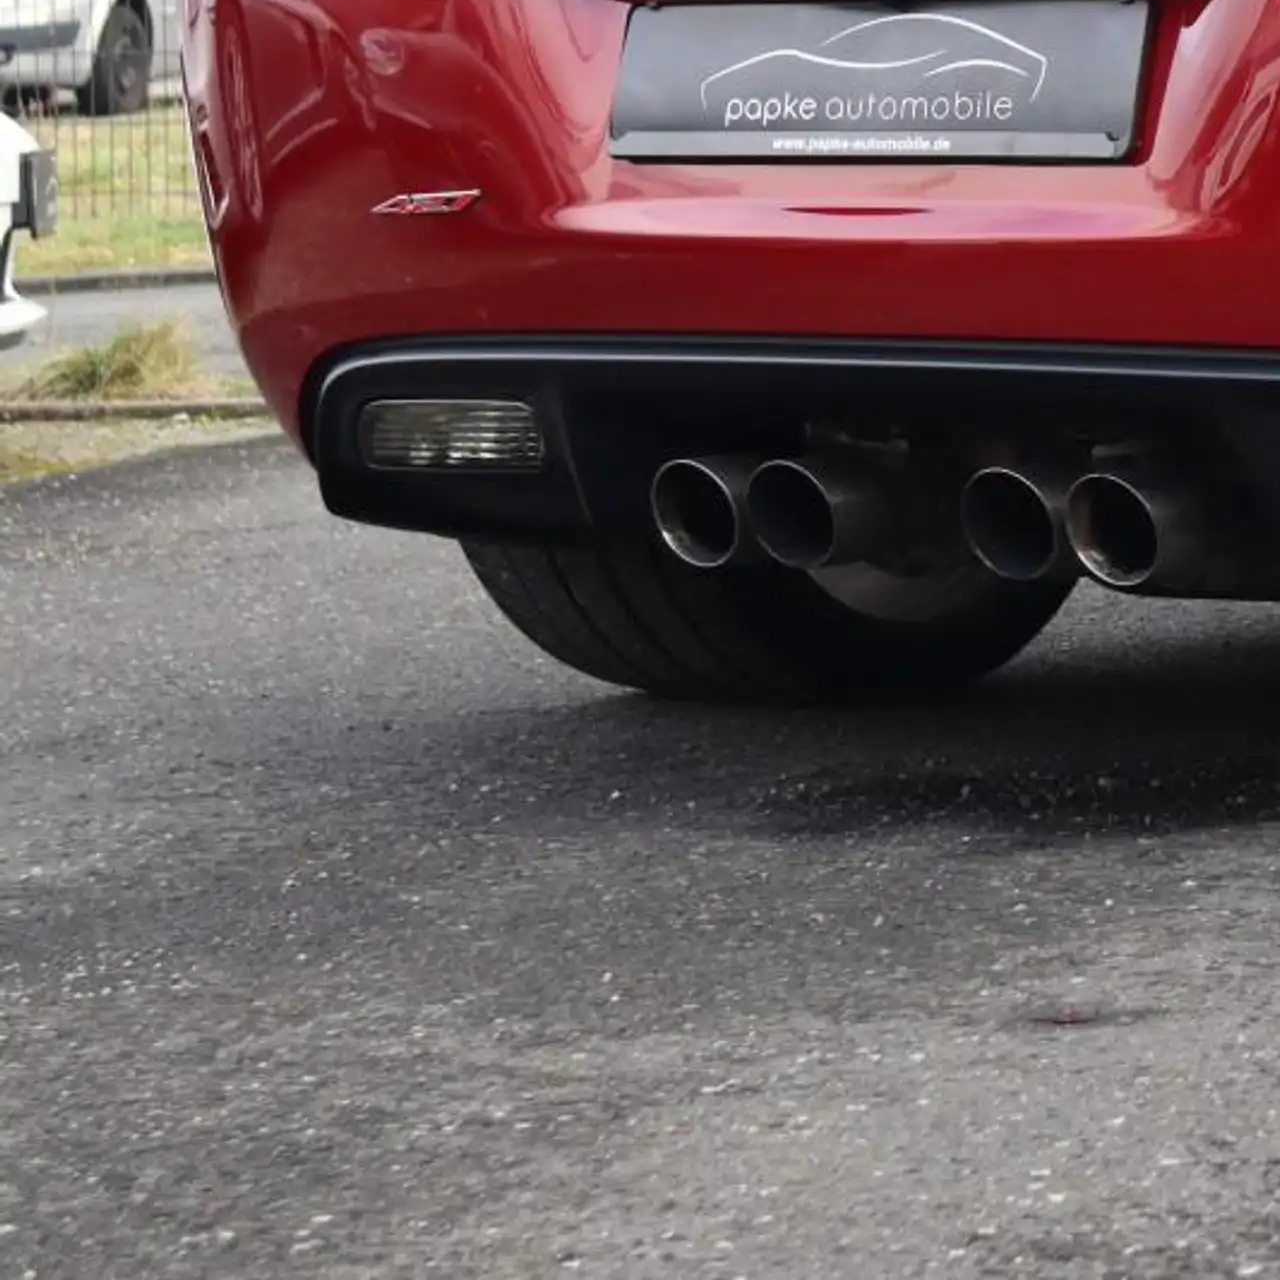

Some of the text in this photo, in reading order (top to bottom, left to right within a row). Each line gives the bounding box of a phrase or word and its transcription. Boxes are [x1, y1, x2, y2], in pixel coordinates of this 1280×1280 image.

[724, 91, 1013, 127] papke automobile
[772, 136, 951, 152] www.papke-automobile.de
